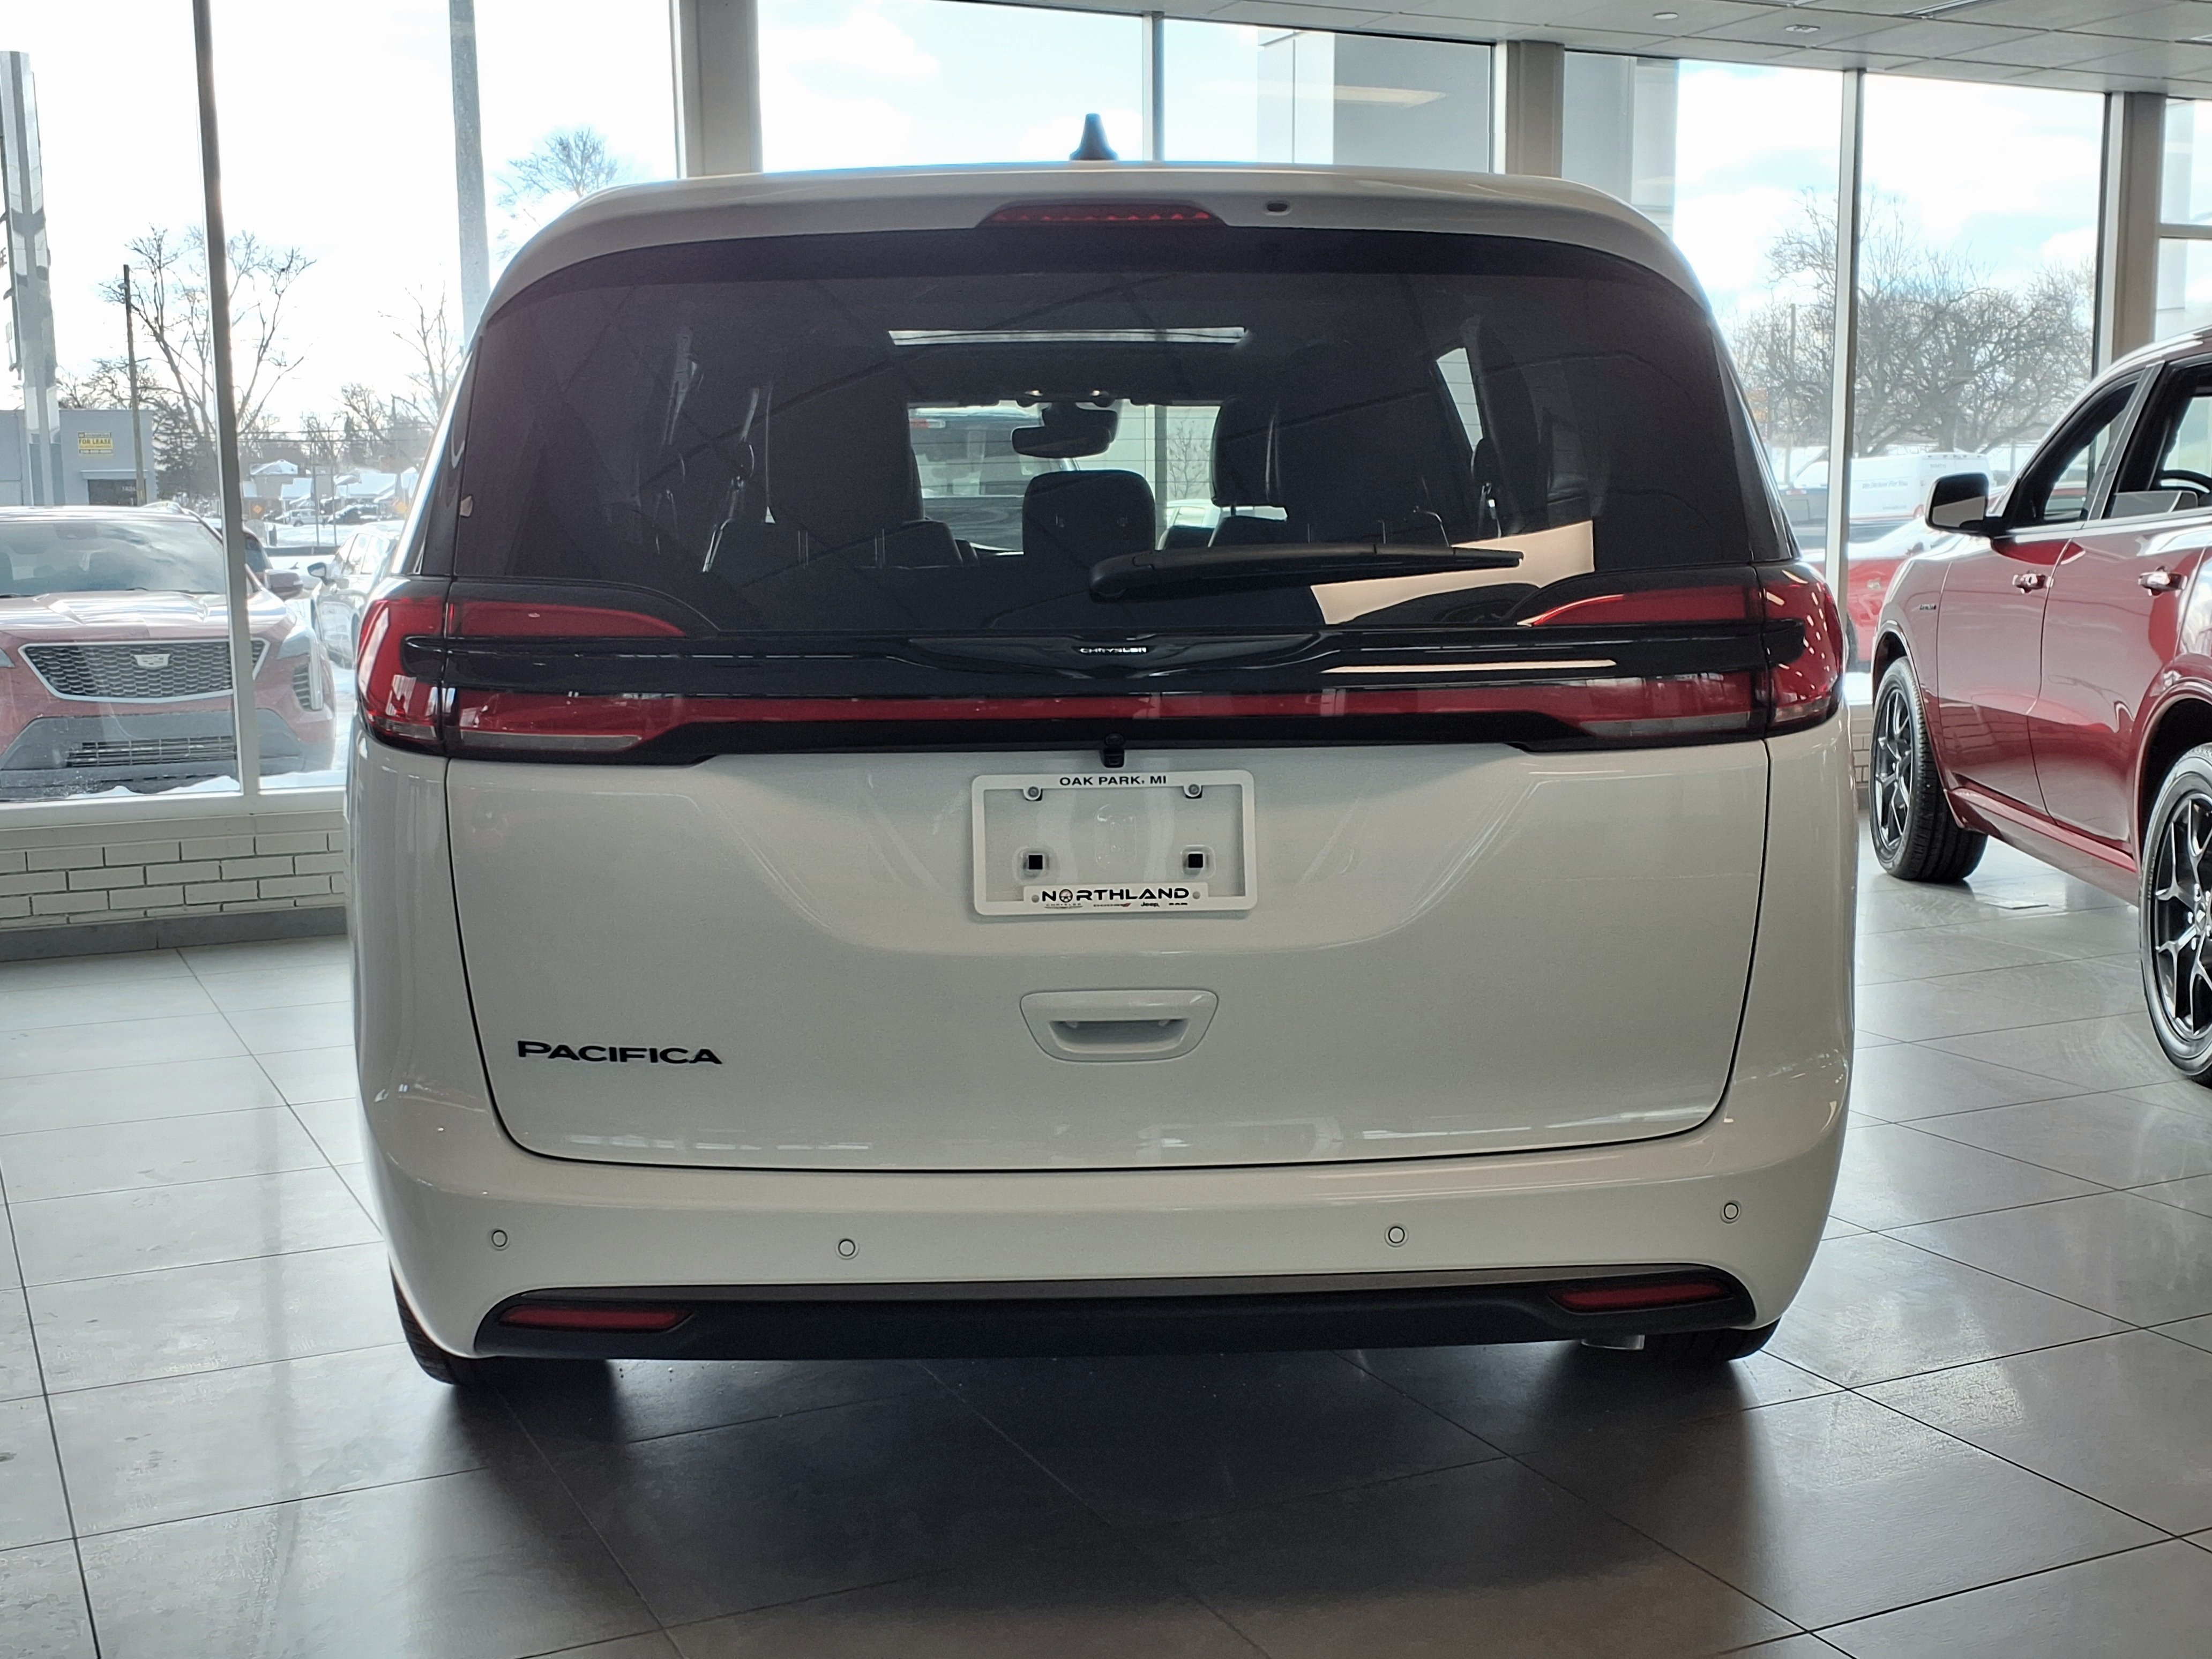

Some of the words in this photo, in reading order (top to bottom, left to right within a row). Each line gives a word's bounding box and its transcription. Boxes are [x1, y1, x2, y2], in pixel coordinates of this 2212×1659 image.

[1059, 776, 1093, 786] OAK
[1098, 776, 1145, 786] PARK,
[1150, 775, 1167, 784] MI
[1042, 888, 1189, 903] NORTHLAND
[518, 1041, 722, 1064] PACIFICA
